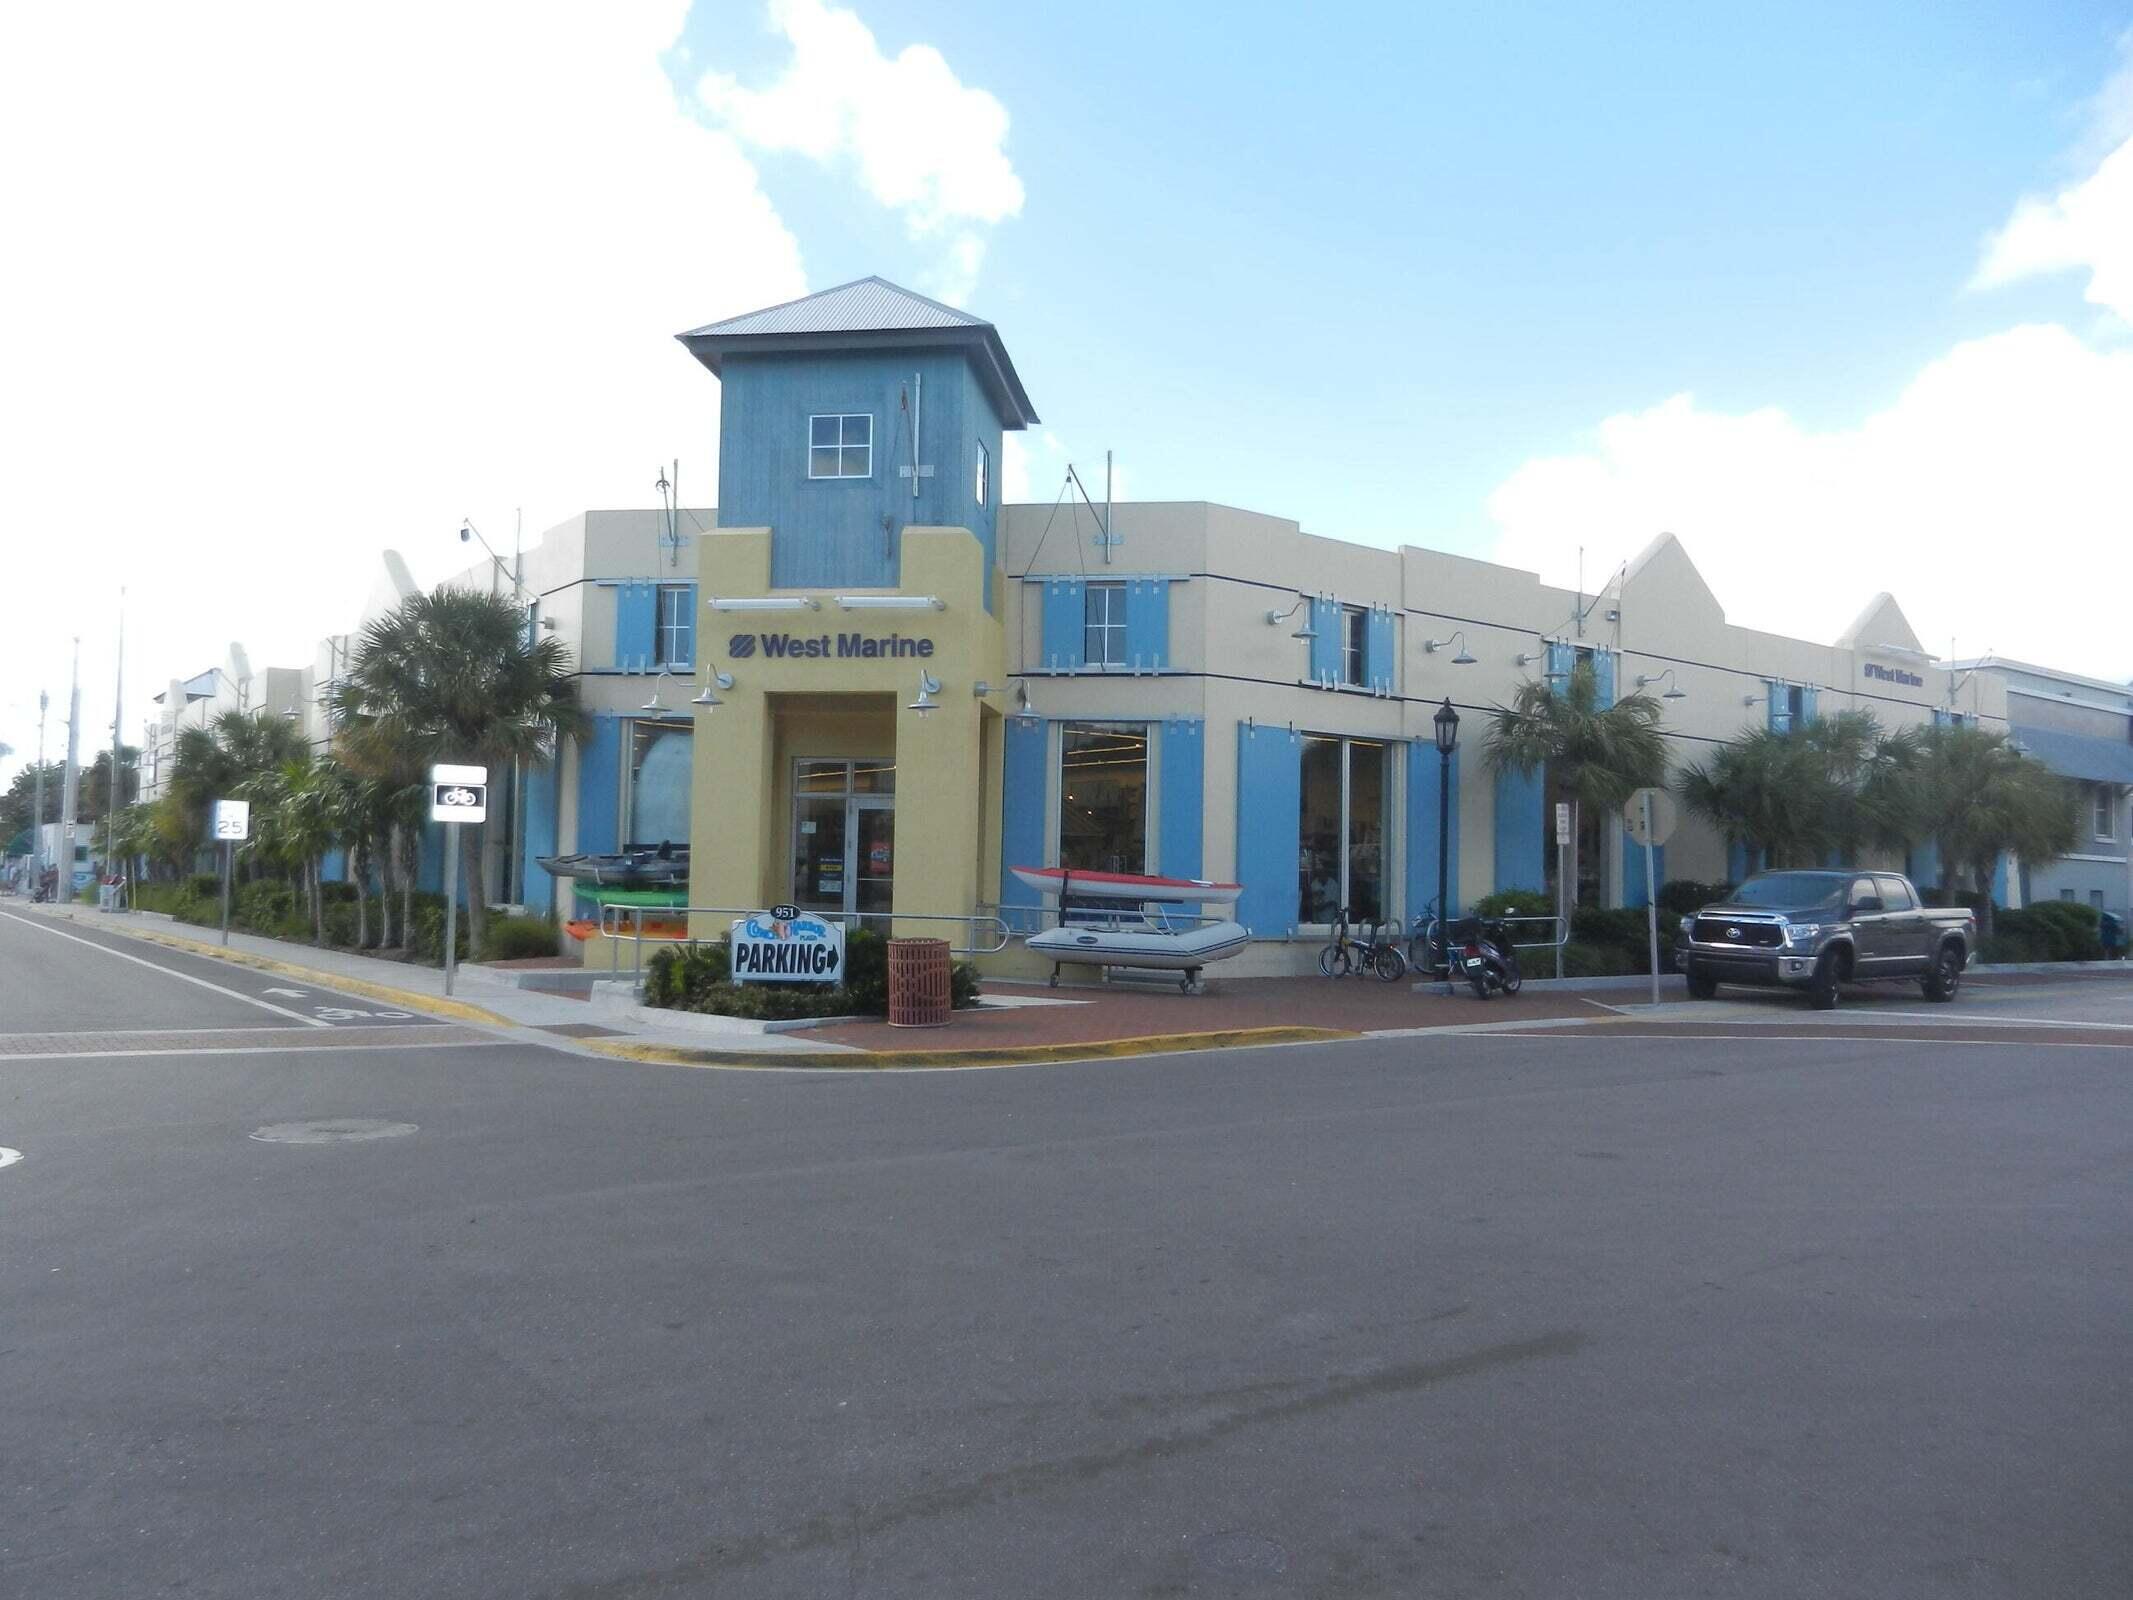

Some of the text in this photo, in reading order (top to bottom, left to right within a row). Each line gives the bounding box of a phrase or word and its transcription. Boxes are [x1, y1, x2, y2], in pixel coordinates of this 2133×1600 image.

[761, 633, 935, 658] West Marine
[217, 820, 243, 834] 25
[775, 907, 794, 918] 951
[735, 943, 826, 974] PARKING
